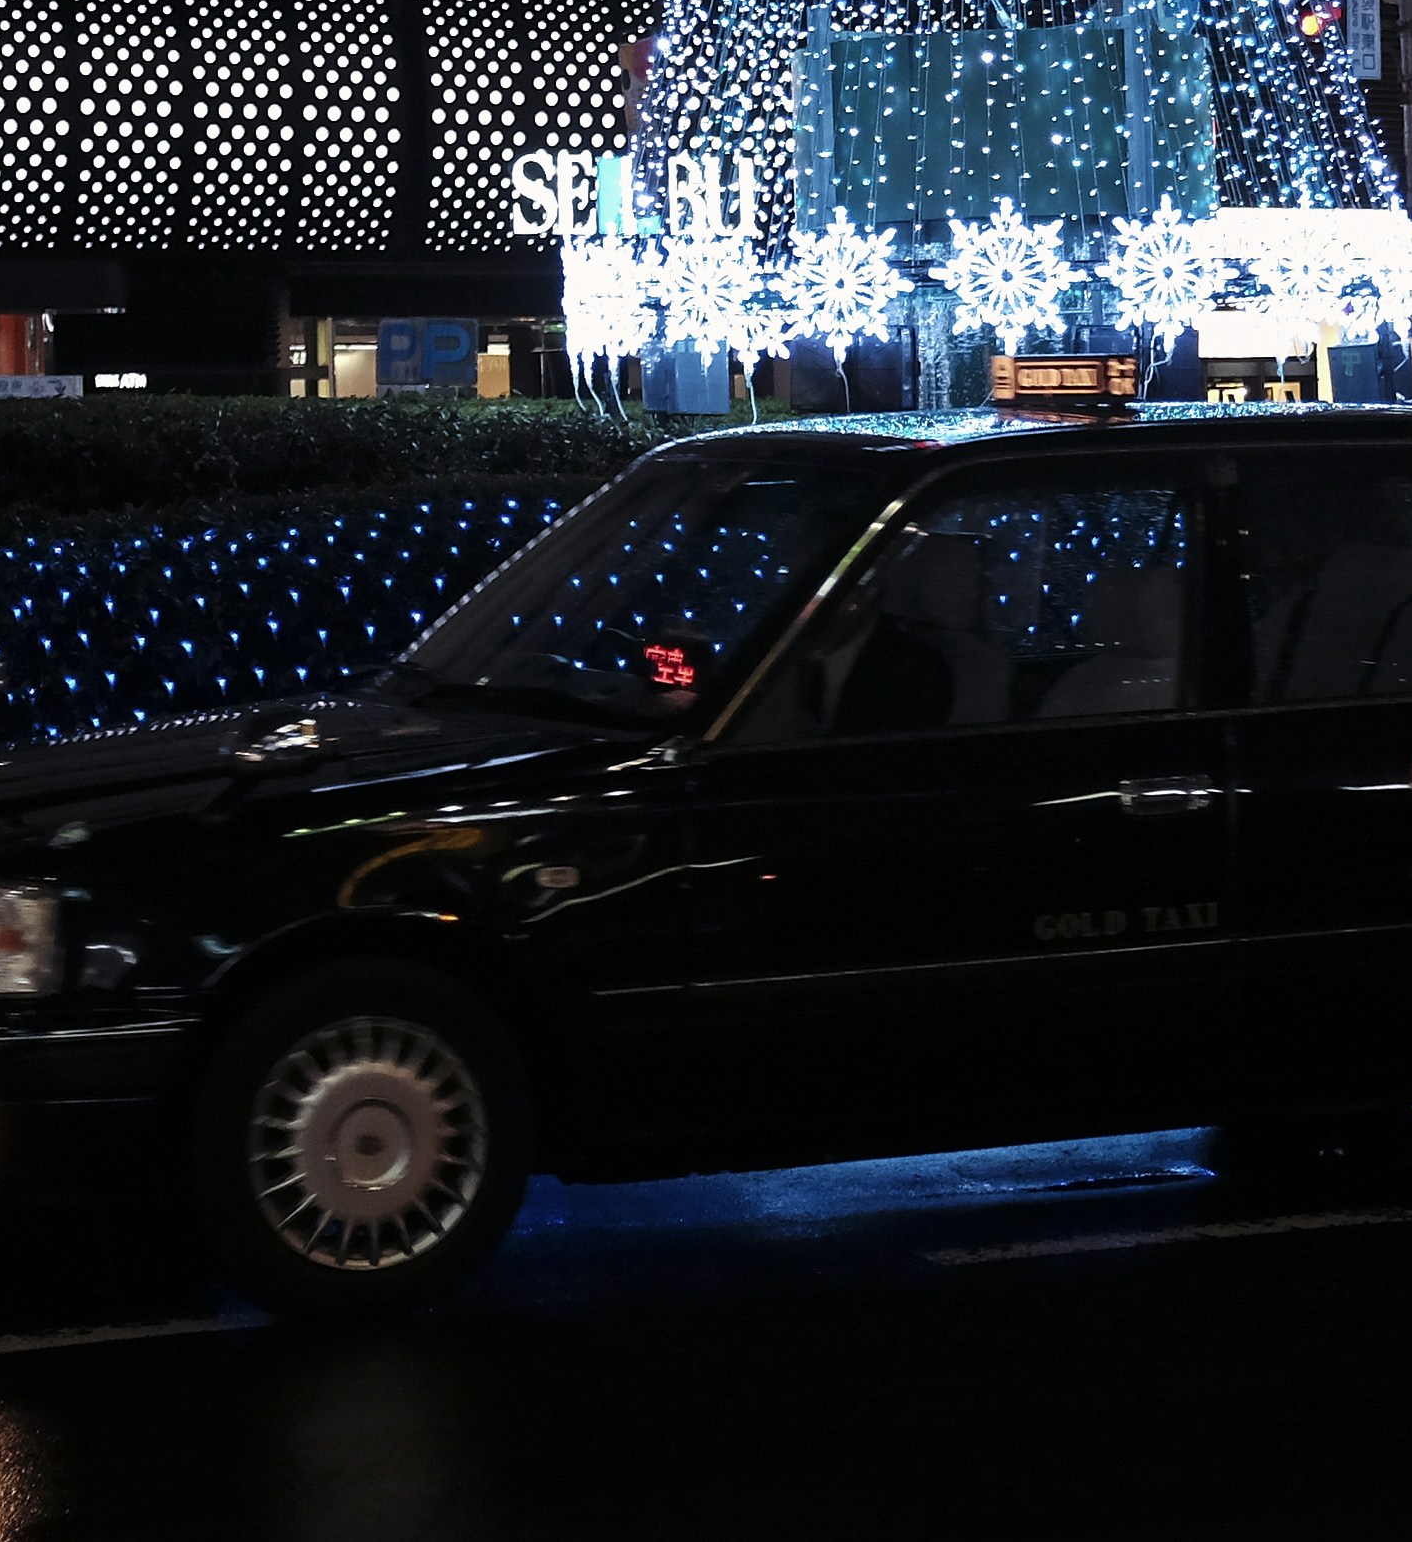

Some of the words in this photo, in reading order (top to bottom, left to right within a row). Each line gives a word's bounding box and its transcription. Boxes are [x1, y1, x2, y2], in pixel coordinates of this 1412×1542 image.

[425, 322, 470, 380] P
[1033, 909, 1128, 942] GOLD
[1141, 902, 1219, 933] TAXI
